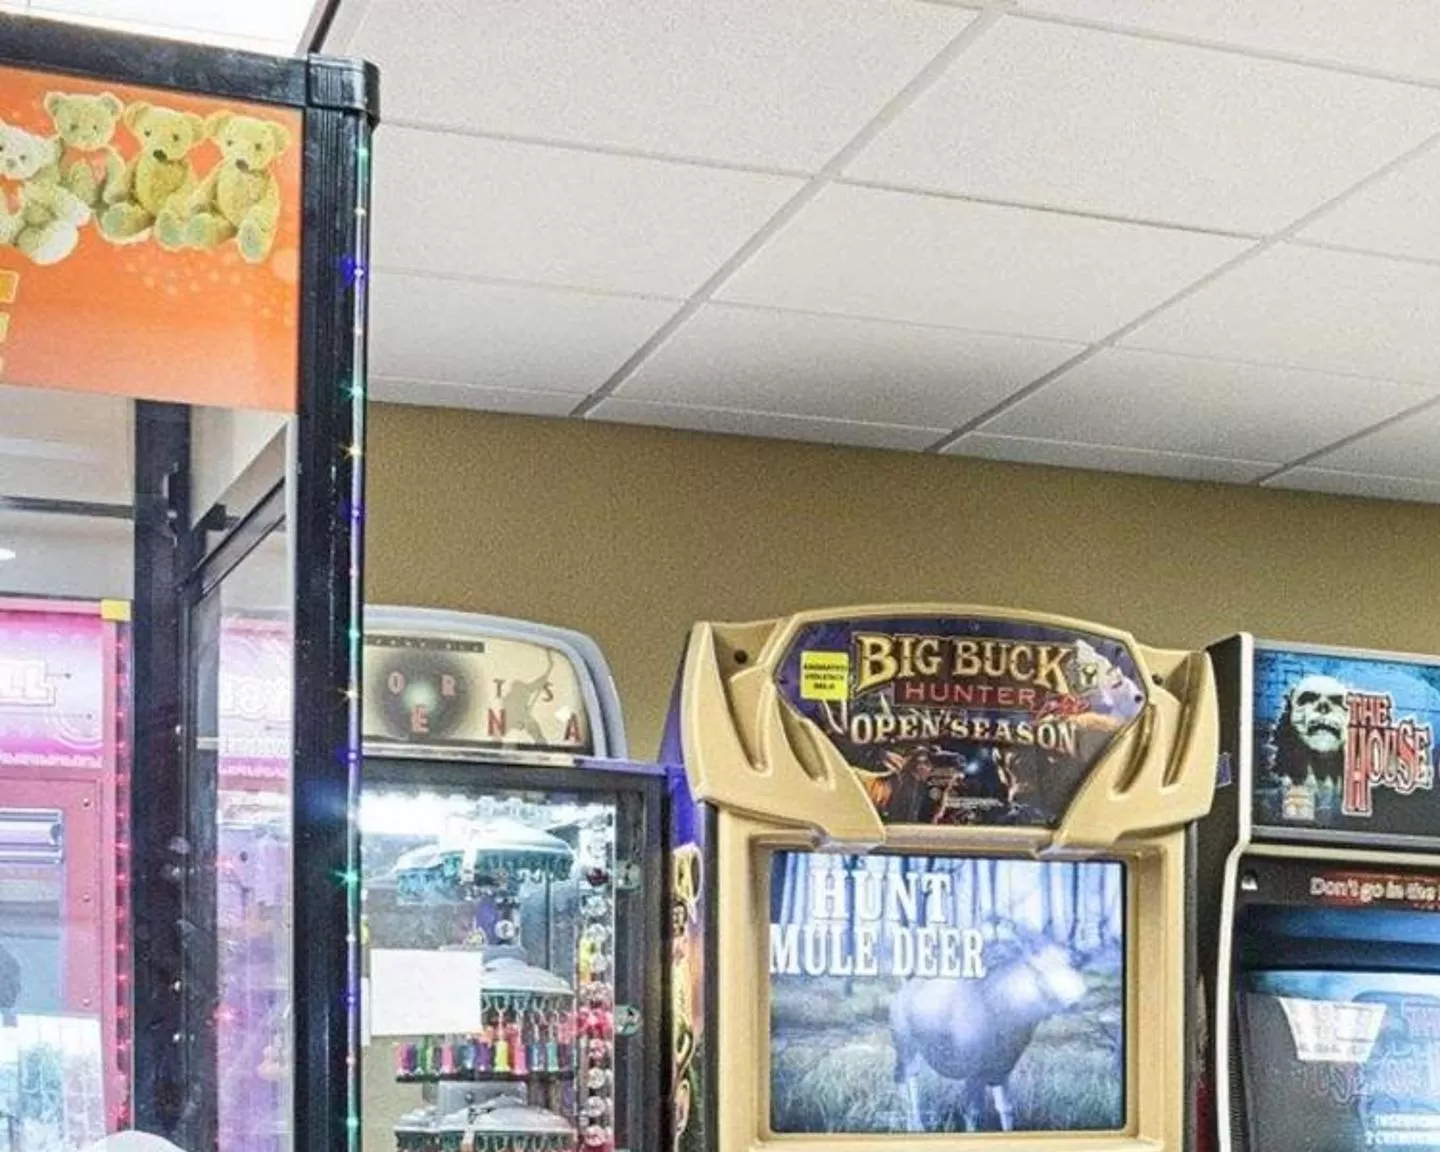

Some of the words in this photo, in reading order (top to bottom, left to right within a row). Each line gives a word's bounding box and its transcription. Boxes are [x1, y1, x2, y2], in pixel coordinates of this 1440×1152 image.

[854, 633, 943, 695] BIG
[952, 641, 1073, 696] BUCK
[904, 683, 1037, 705] HUNTER
[1345, 691, 1391, 727] THE
[851, 711, 942, 746] OPEN
[950, 715, 1079, 755] SEASON
[1342, 716, 1434, 816] HOUSE
[812, 869, 952, 923] HUNT
[1310, 877, 1359, 898] Don't
[1360, 882, 1385, 903] go
[769, 922, 879, 977] MULE
[892, 926, 987, 979] DEER
